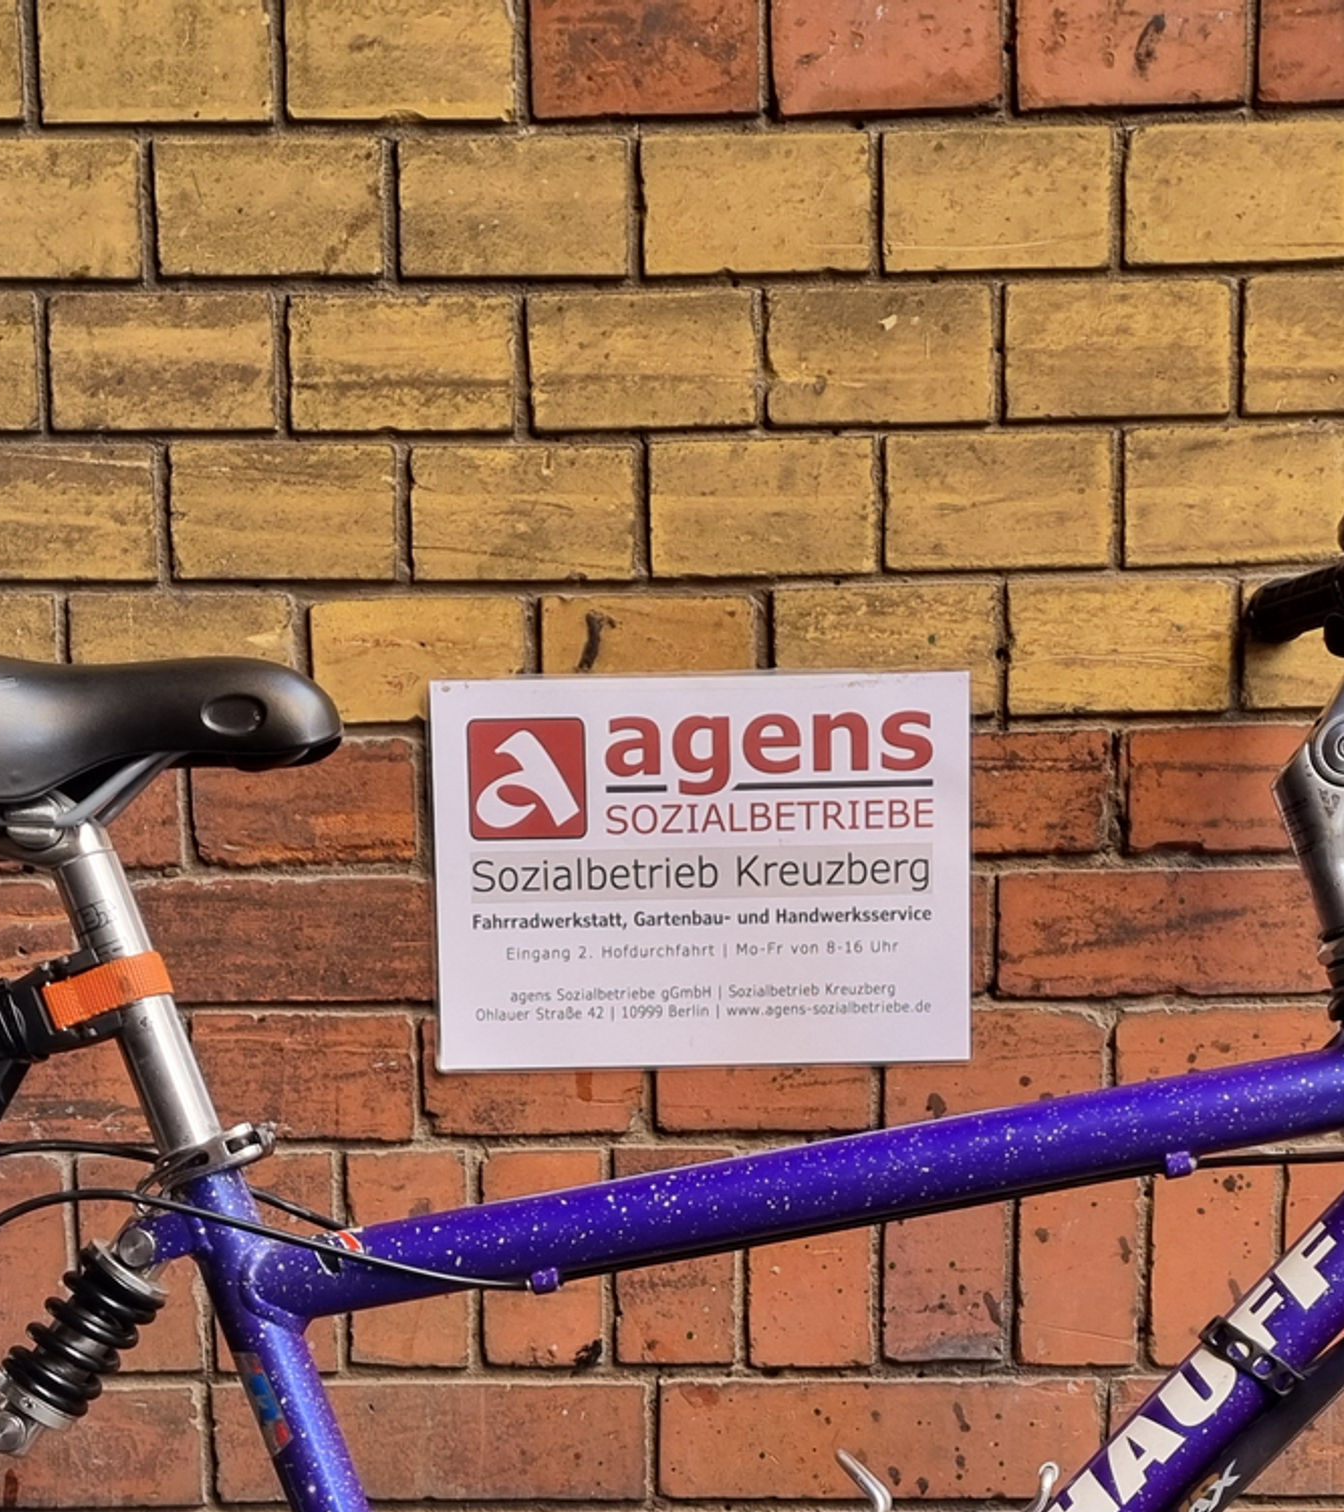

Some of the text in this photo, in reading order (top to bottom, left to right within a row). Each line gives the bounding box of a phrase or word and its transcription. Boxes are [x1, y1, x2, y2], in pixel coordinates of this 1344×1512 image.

[604, 711, 934, 796] agens
[605, 798, 934, 835] SOZIALBETRIEBE
[472, 852, 930, 893] Sozialbetrieb Kreuzberg
[472, 906, 932, 930] Fahrradwerkstatt, Gartenbau- und Handwerksservice
[506, 946, 571, 963] Eingang
[578, 945, 593, 960] 2.
[601, 943, 716, 959] Hofdurchfahrt
[735, 941, 784, 957] Mo-Fr
[790, 943, 819, 955] von
[826, 940, 864, 954] 8-16
[870, 939, 900, 953] Uhr
[510, 990, 552, 1004] agens
[556, 986, 656, 1002] Sozialbetriebe
[661, 985, 712, 1002] gGmbH
[728, 983, 820, 999] Sozialbetrieb
[824, 982, 896, 998] Kreuzberg
[475, 1006, 530, 1022] Ohlauer
[536, 1005, 583, 1021] Straße
[587, 1005, 605, 1020] 42
[622, 1004, 664, 1020] 10999
[668, 1003, 710, 1018] Berlin
[726, 999, 933, 1019] www.agens-sozialbetriebe.de
